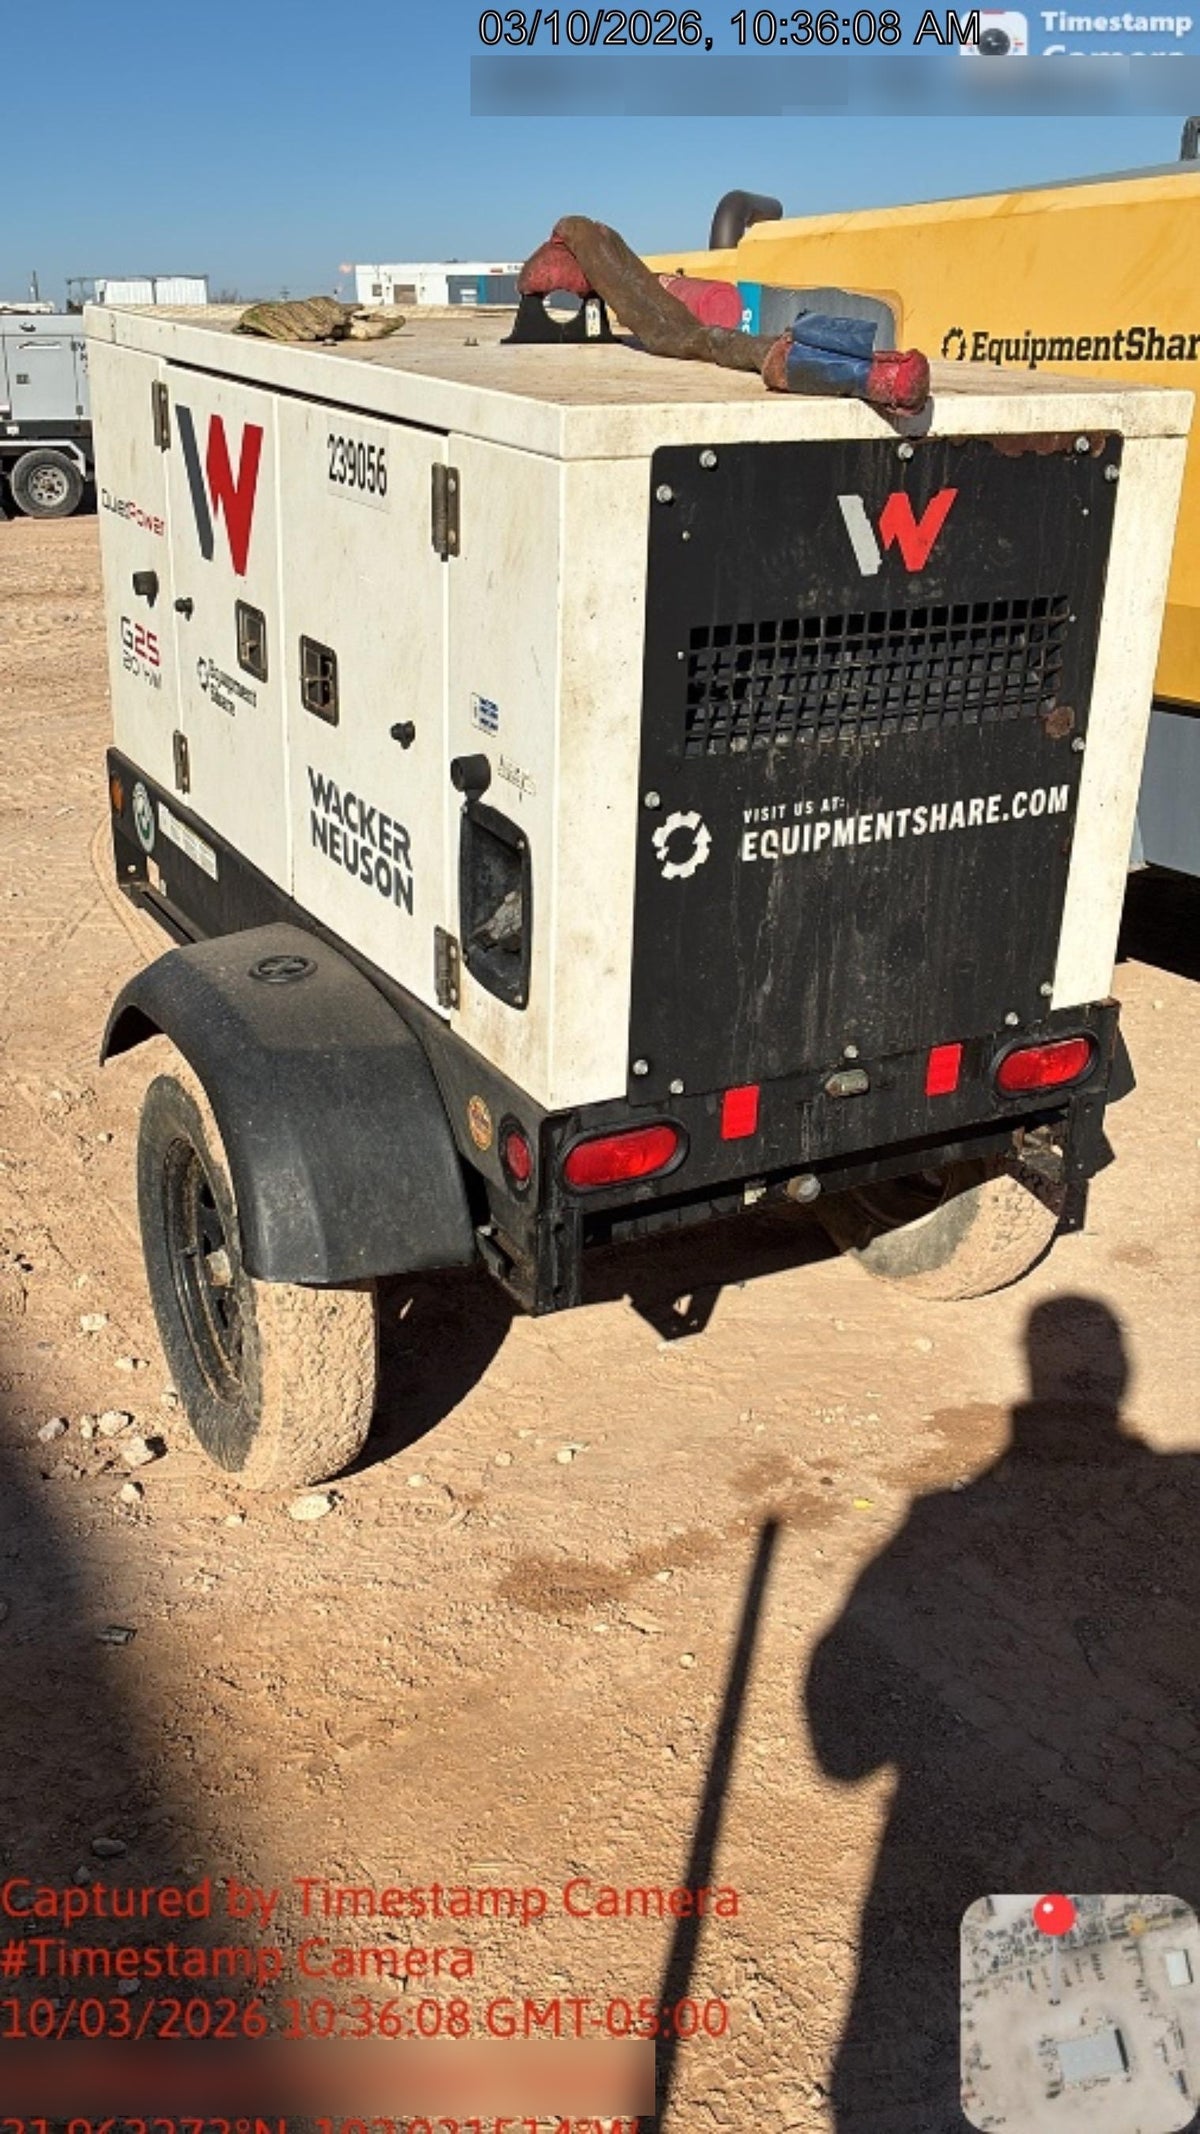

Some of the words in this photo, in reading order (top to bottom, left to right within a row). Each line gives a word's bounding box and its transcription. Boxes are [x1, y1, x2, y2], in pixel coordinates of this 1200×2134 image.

[327, 432, 388, 497] 239056
[120, 615, 160, 667] G25
[308, 765, 413, 871] WACKER
[741, 784, 1071, 862] EQUIPMENTSHARE.COM
[743, 803, 786, 824] VISIT
[793, 800, 815, 817] US
[820, 796, 846, 813] AT:
[311, 809, 413, 916] NEUSON
